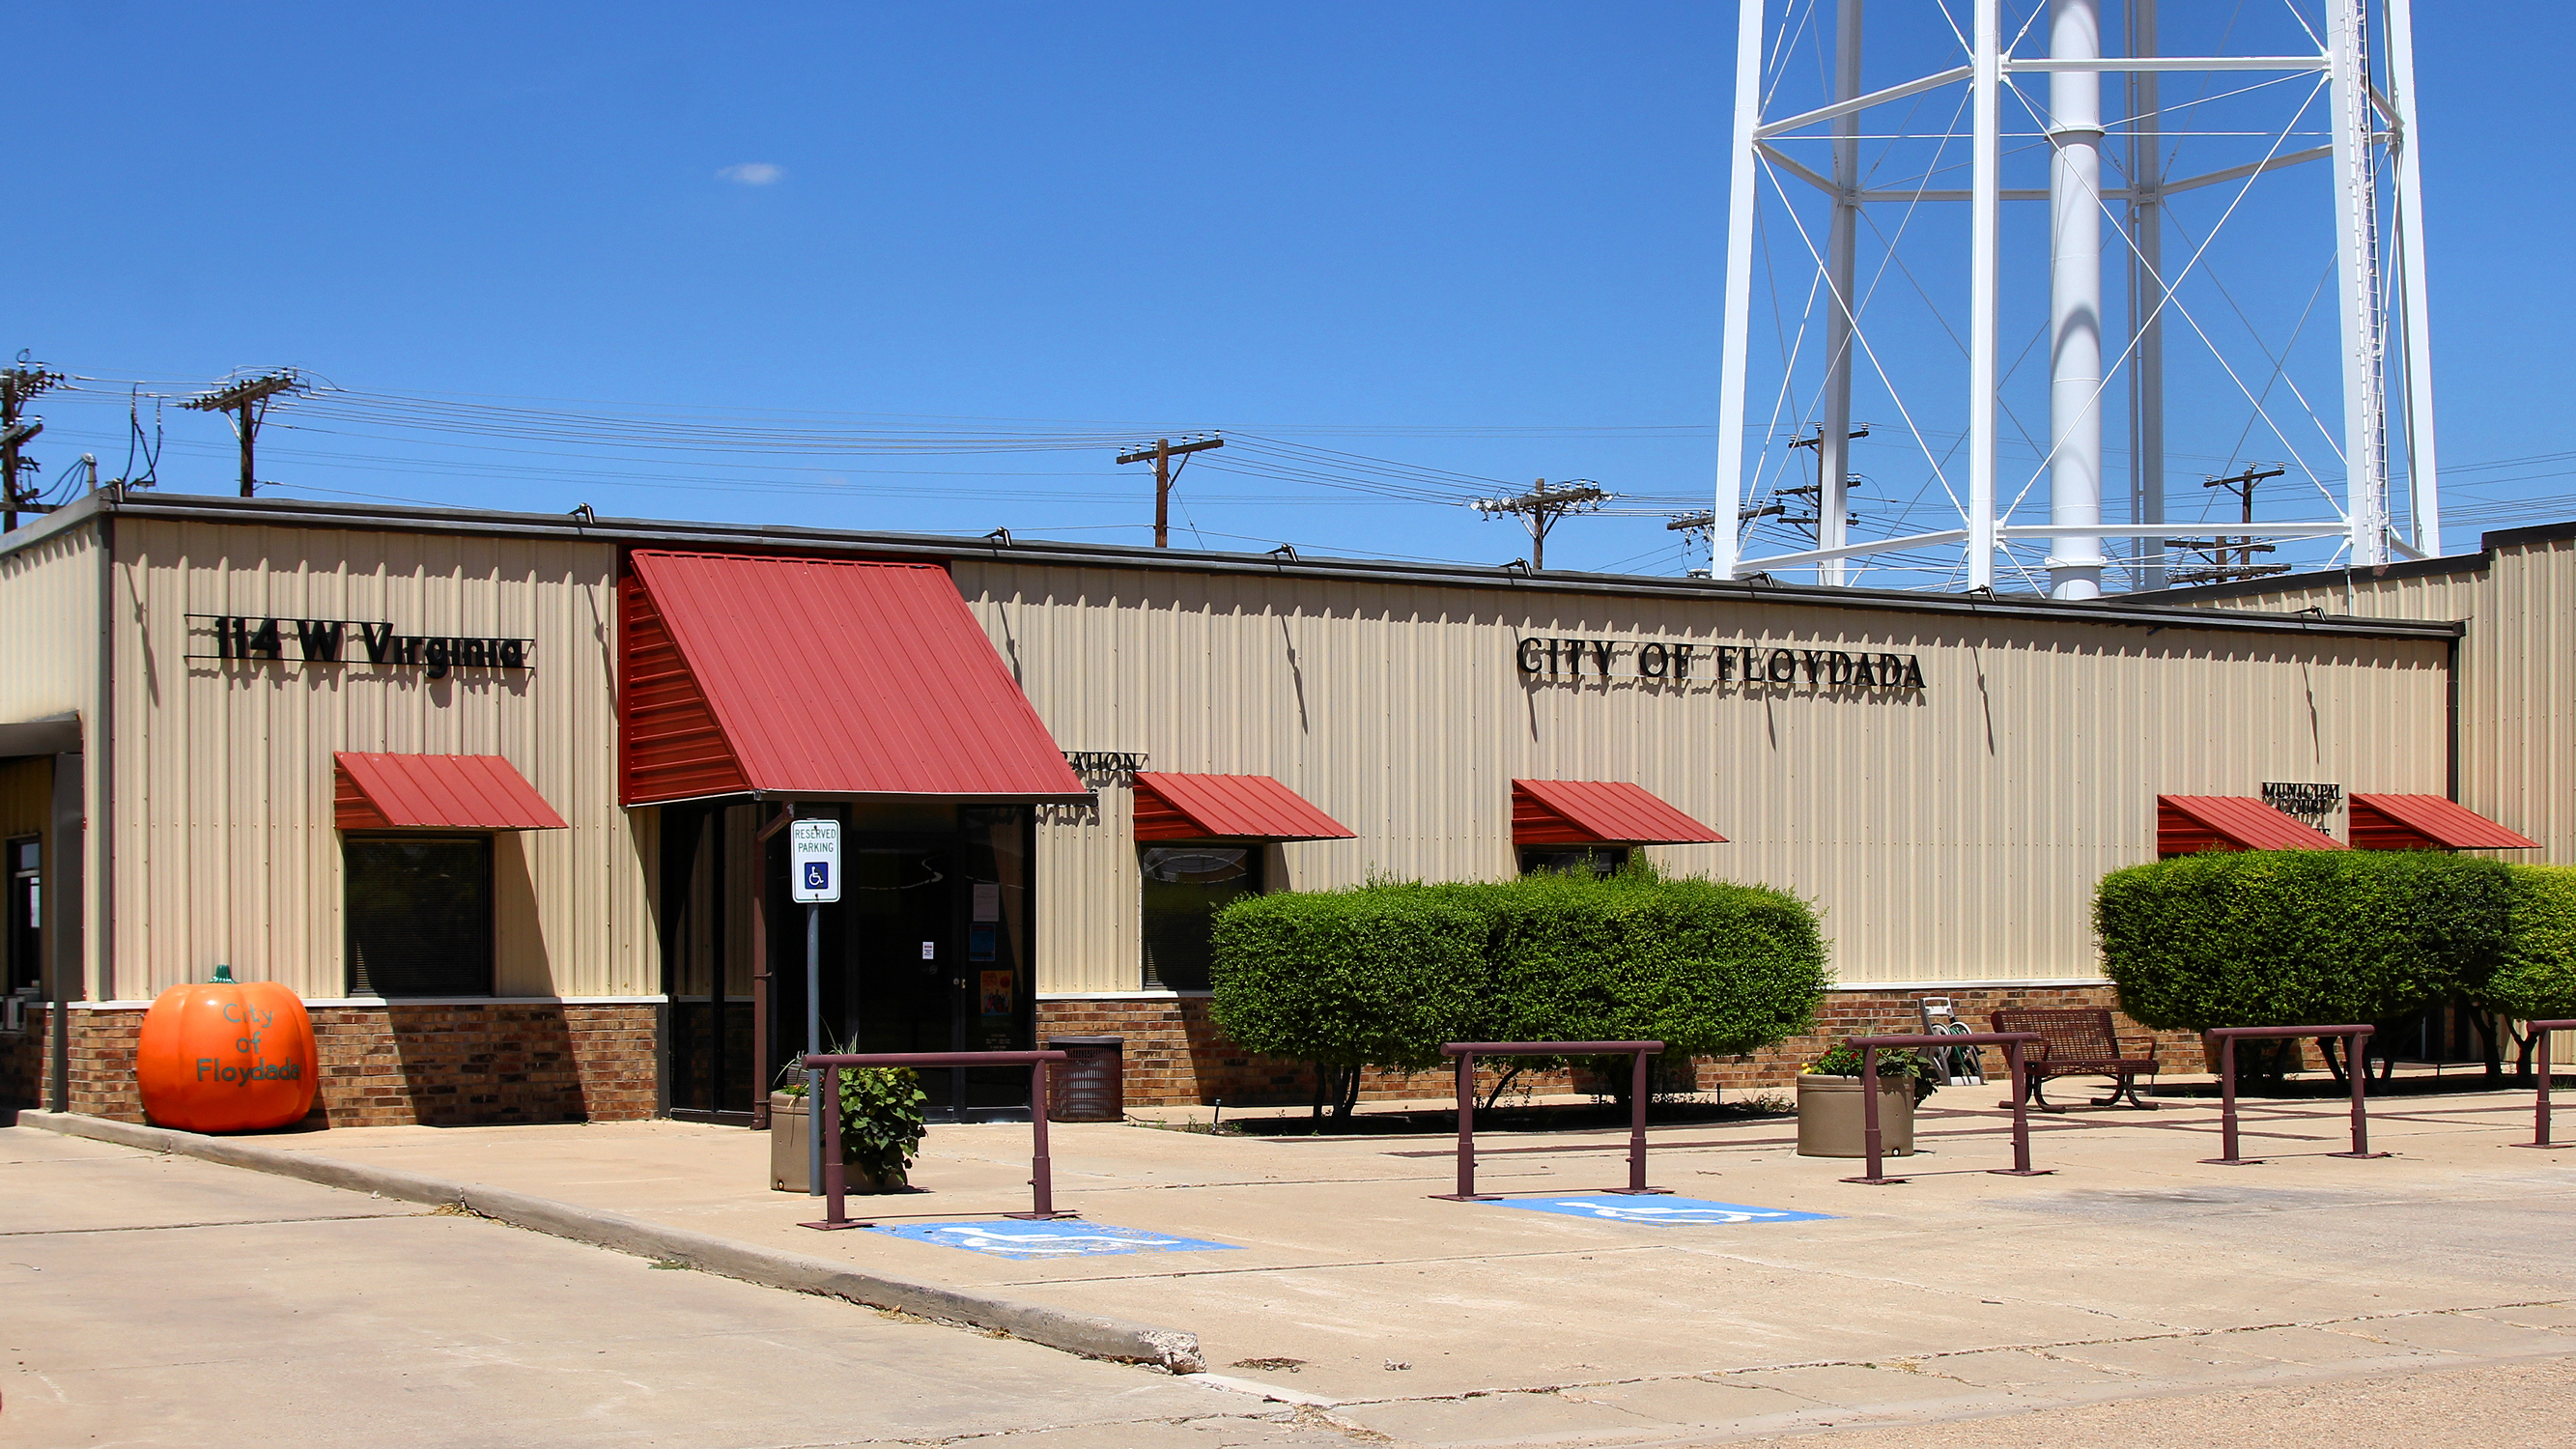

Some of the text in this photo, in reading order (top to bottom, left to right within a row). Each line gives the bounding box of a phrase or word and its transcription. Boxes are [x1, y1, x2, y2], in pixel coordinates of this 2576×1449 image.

[214, 615, 524, 679] 114 W Virginia
[1515, 637, 1927, 689] CITY OF FLOYDADA
[1062, 751, 1137, 773] ATION
[2261, 781, 2343, 800] MUNICIPAL
[2278, 798, 2328, 815] COURT
[795, 828, 836, 839] RESERVED
[798, 841, 835, 853] PARKING
[223, 1003, 274, 1029] City
[237, 1031, 262, 1055] of
[196, 1057, 301, 1088] Floydada
